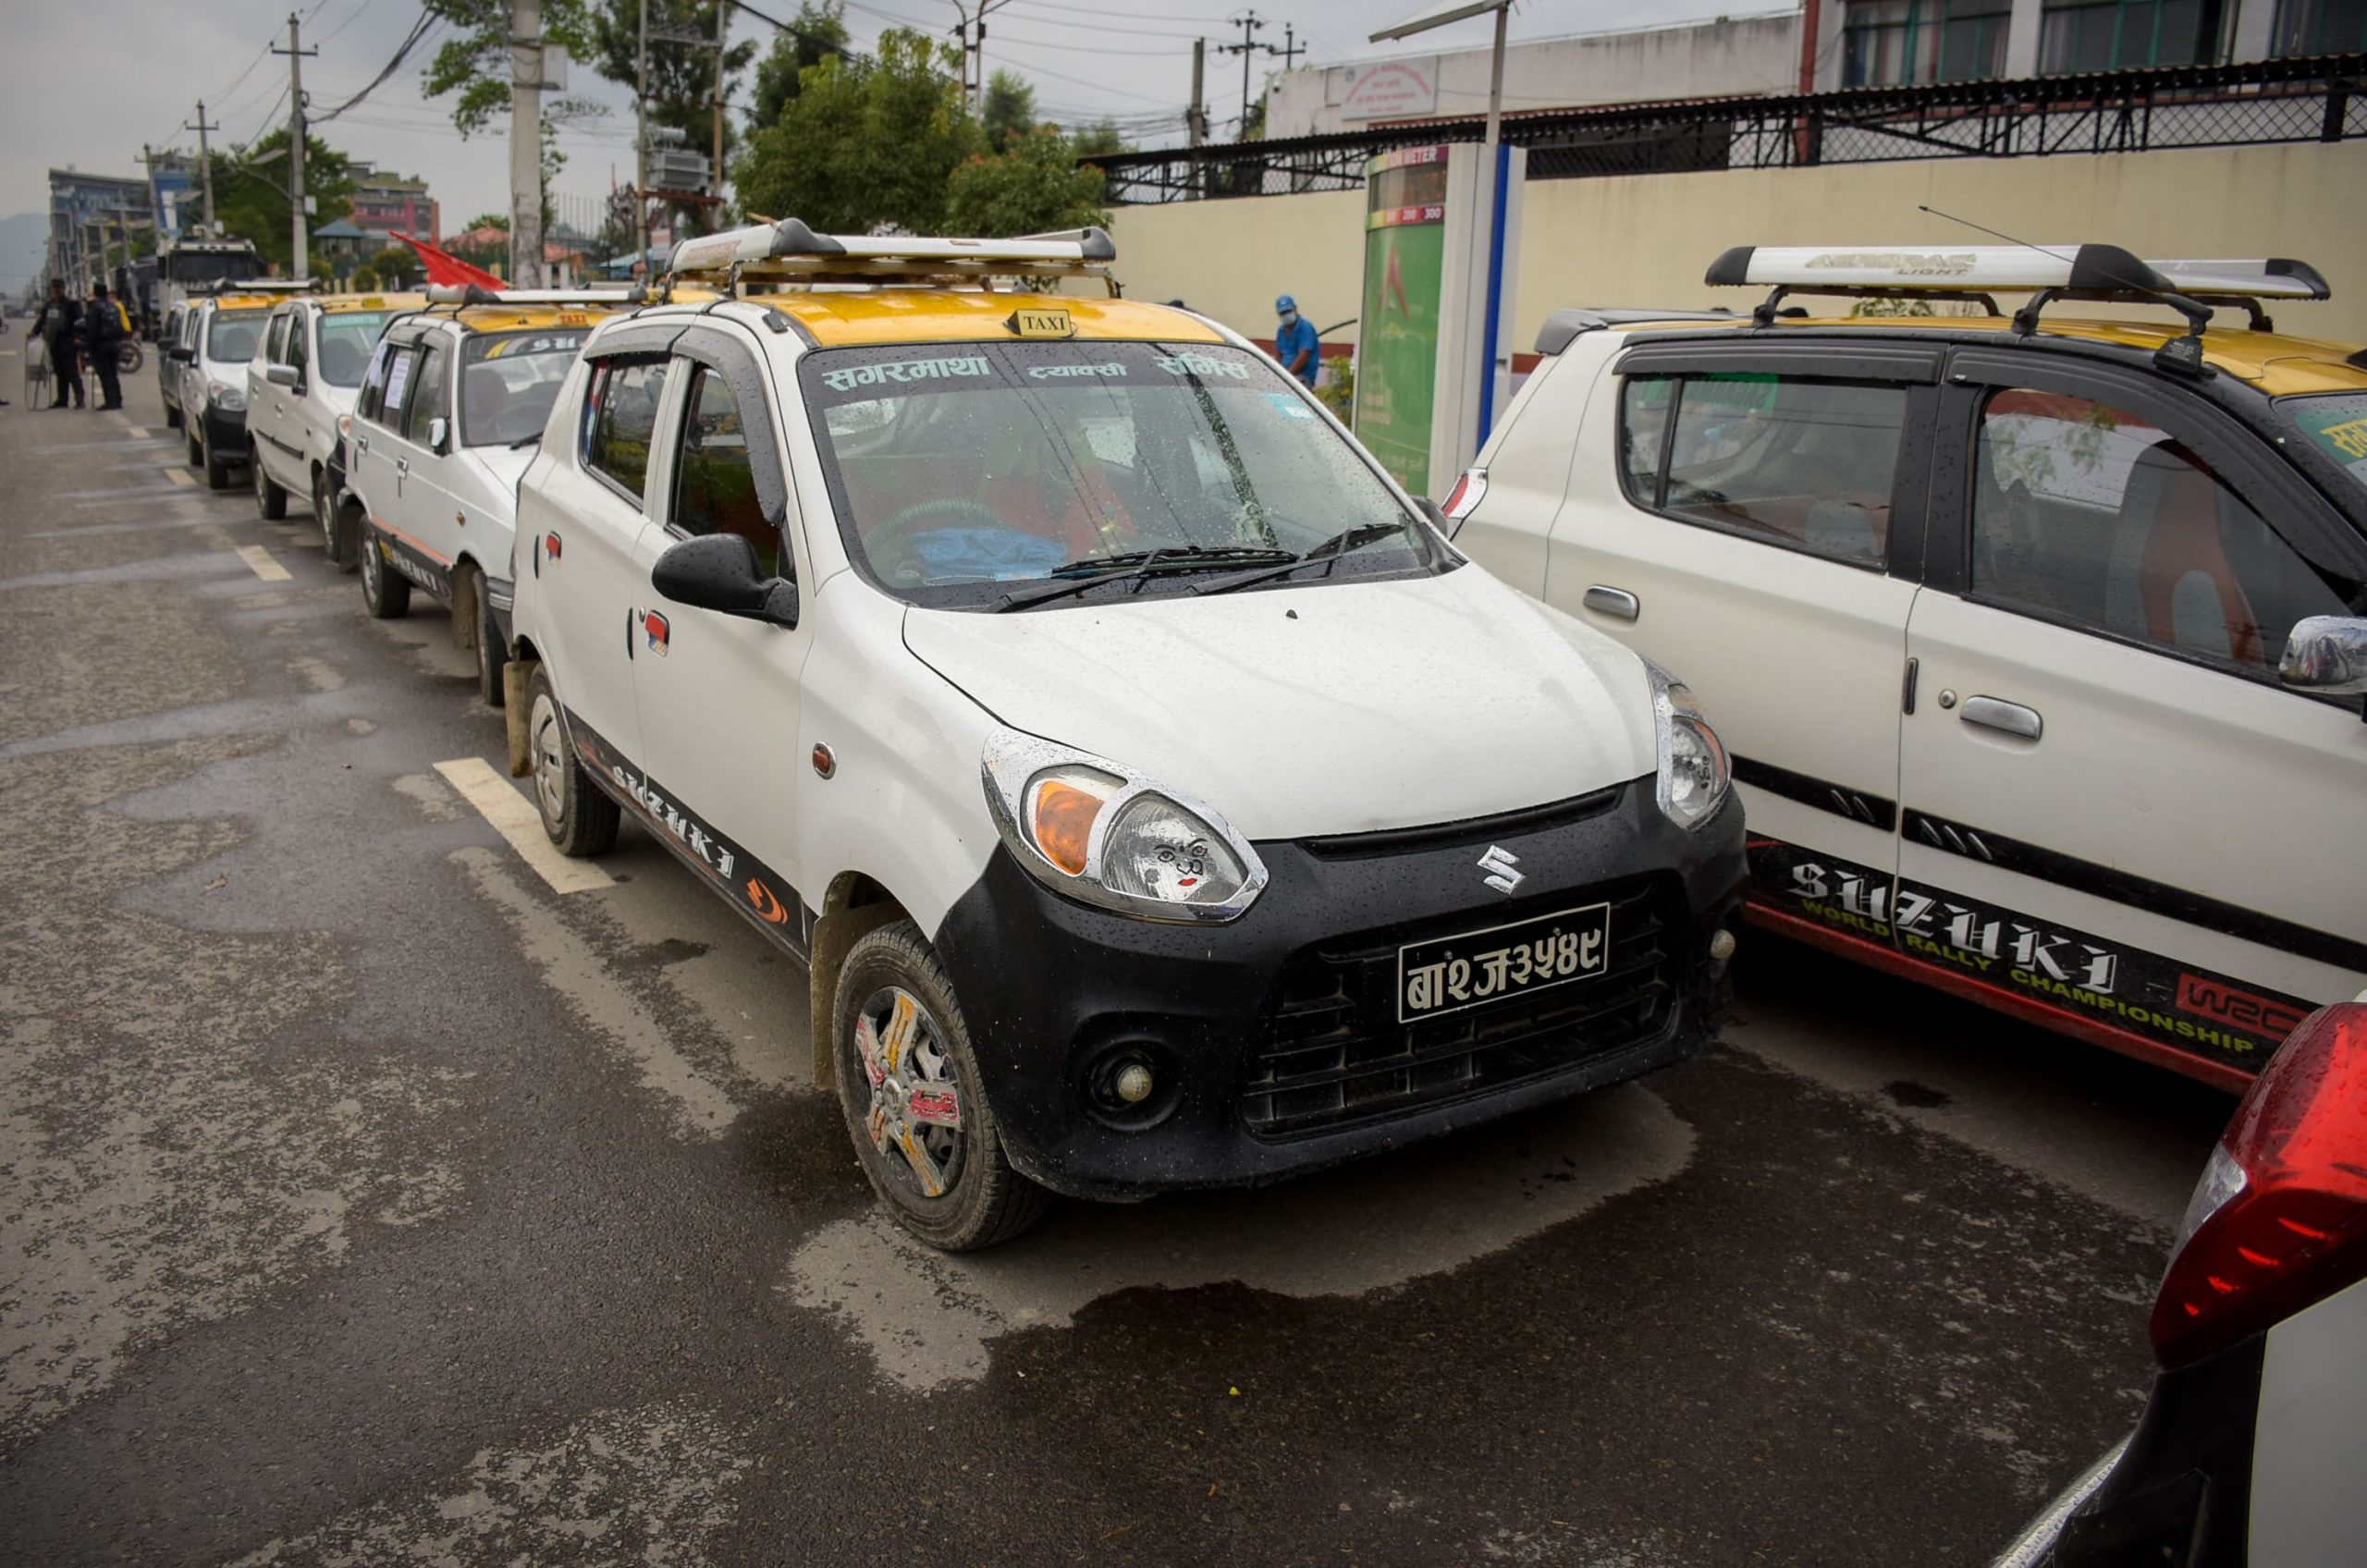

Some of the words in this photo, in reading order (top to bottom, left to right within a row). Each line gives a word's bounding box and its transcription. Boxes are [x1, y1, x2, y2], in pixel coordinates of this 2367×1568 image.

[1424, 207, 1441, 220] 300
[1023, 315, 1066, 331] TAXI
[822, 357, 991, 391] सगरमाथा
[612, 766, 734, 879] SUZUKI
[1787, 863, 2117, 995] SUZUKI
[1802, 899, 1891, 937] WORLD
[1906, 933, 1992, 971] RALLY
[2010, 968, 2256, 1053] CHAMPIONSHIP
